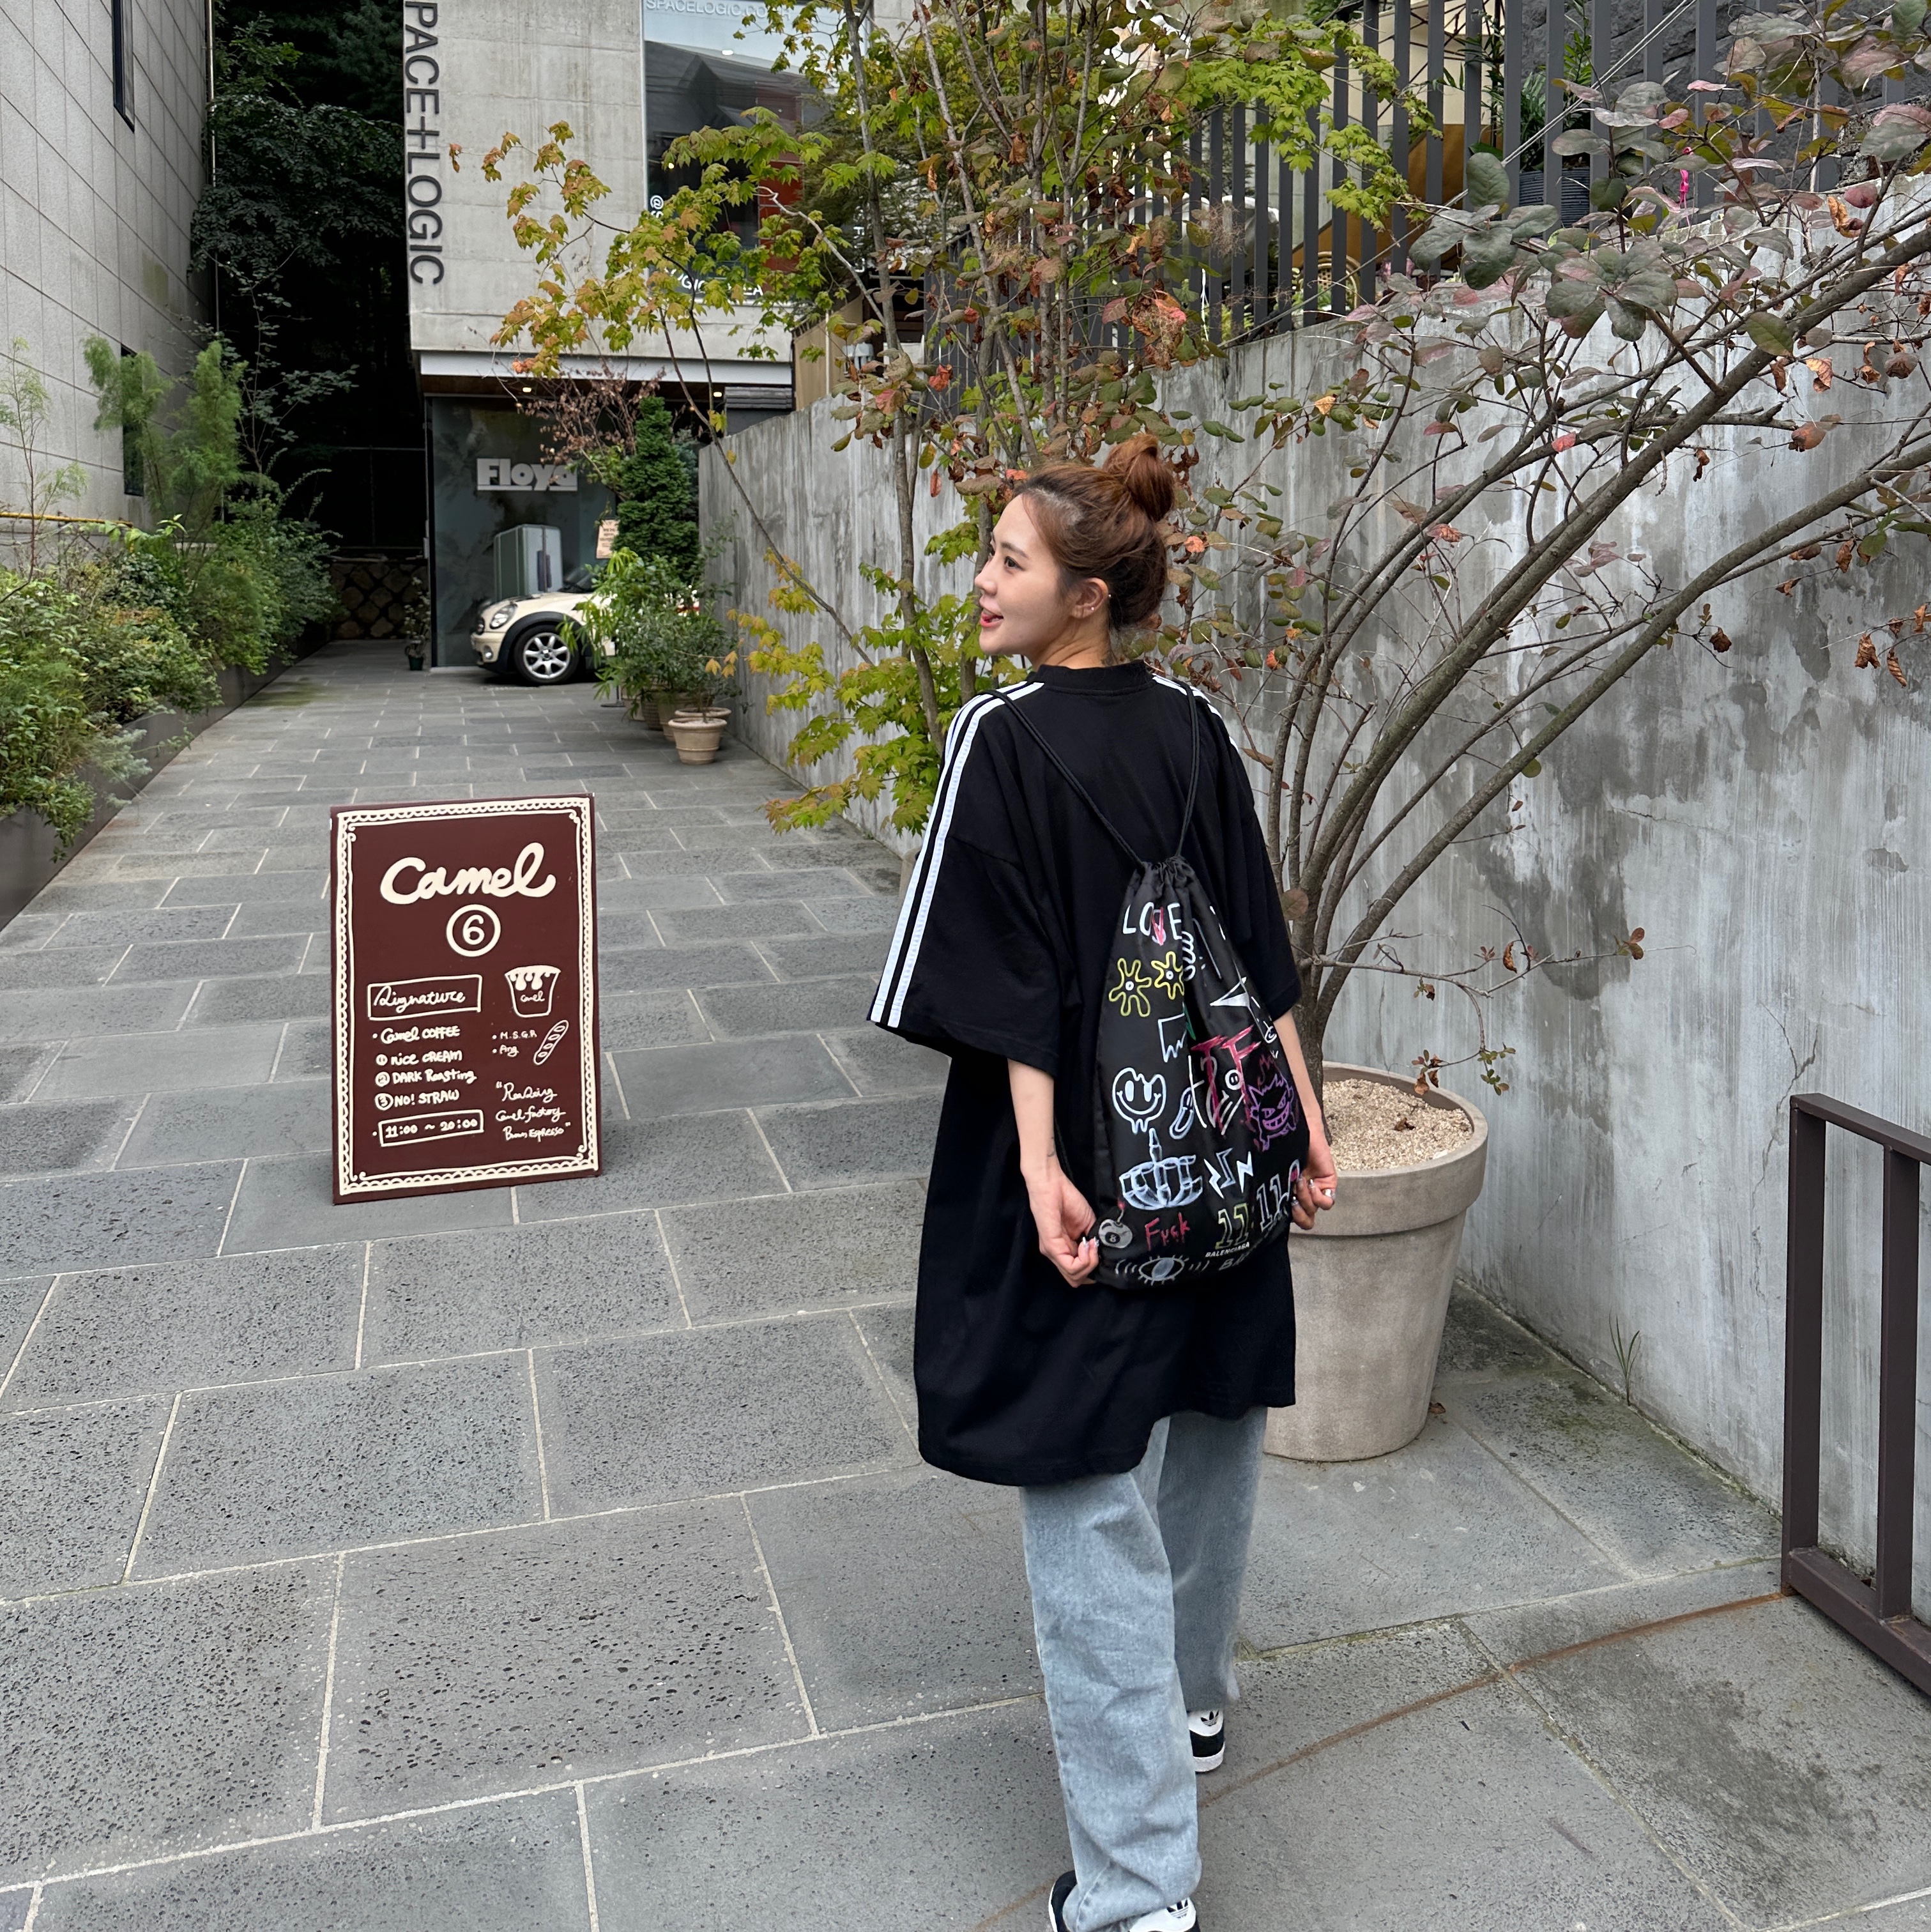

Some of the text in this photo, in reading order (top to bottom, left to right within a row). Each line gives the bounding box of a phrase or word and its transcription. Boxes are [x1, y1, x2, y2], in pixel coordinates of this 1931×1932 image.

[477, 458, 578, 491] Floyd
[381, 842, 556, 905] Camel
[374, 985, 466, 1013] Signature
[381, 1026, 420, 1044] Camel
[392, 1071, 423, 1084] DARK
[418, 1089, 460, 1104] STRAW
[385, 1124, 418, 1138] 11:00
[439, 1118, 478, 1132] 20:00
